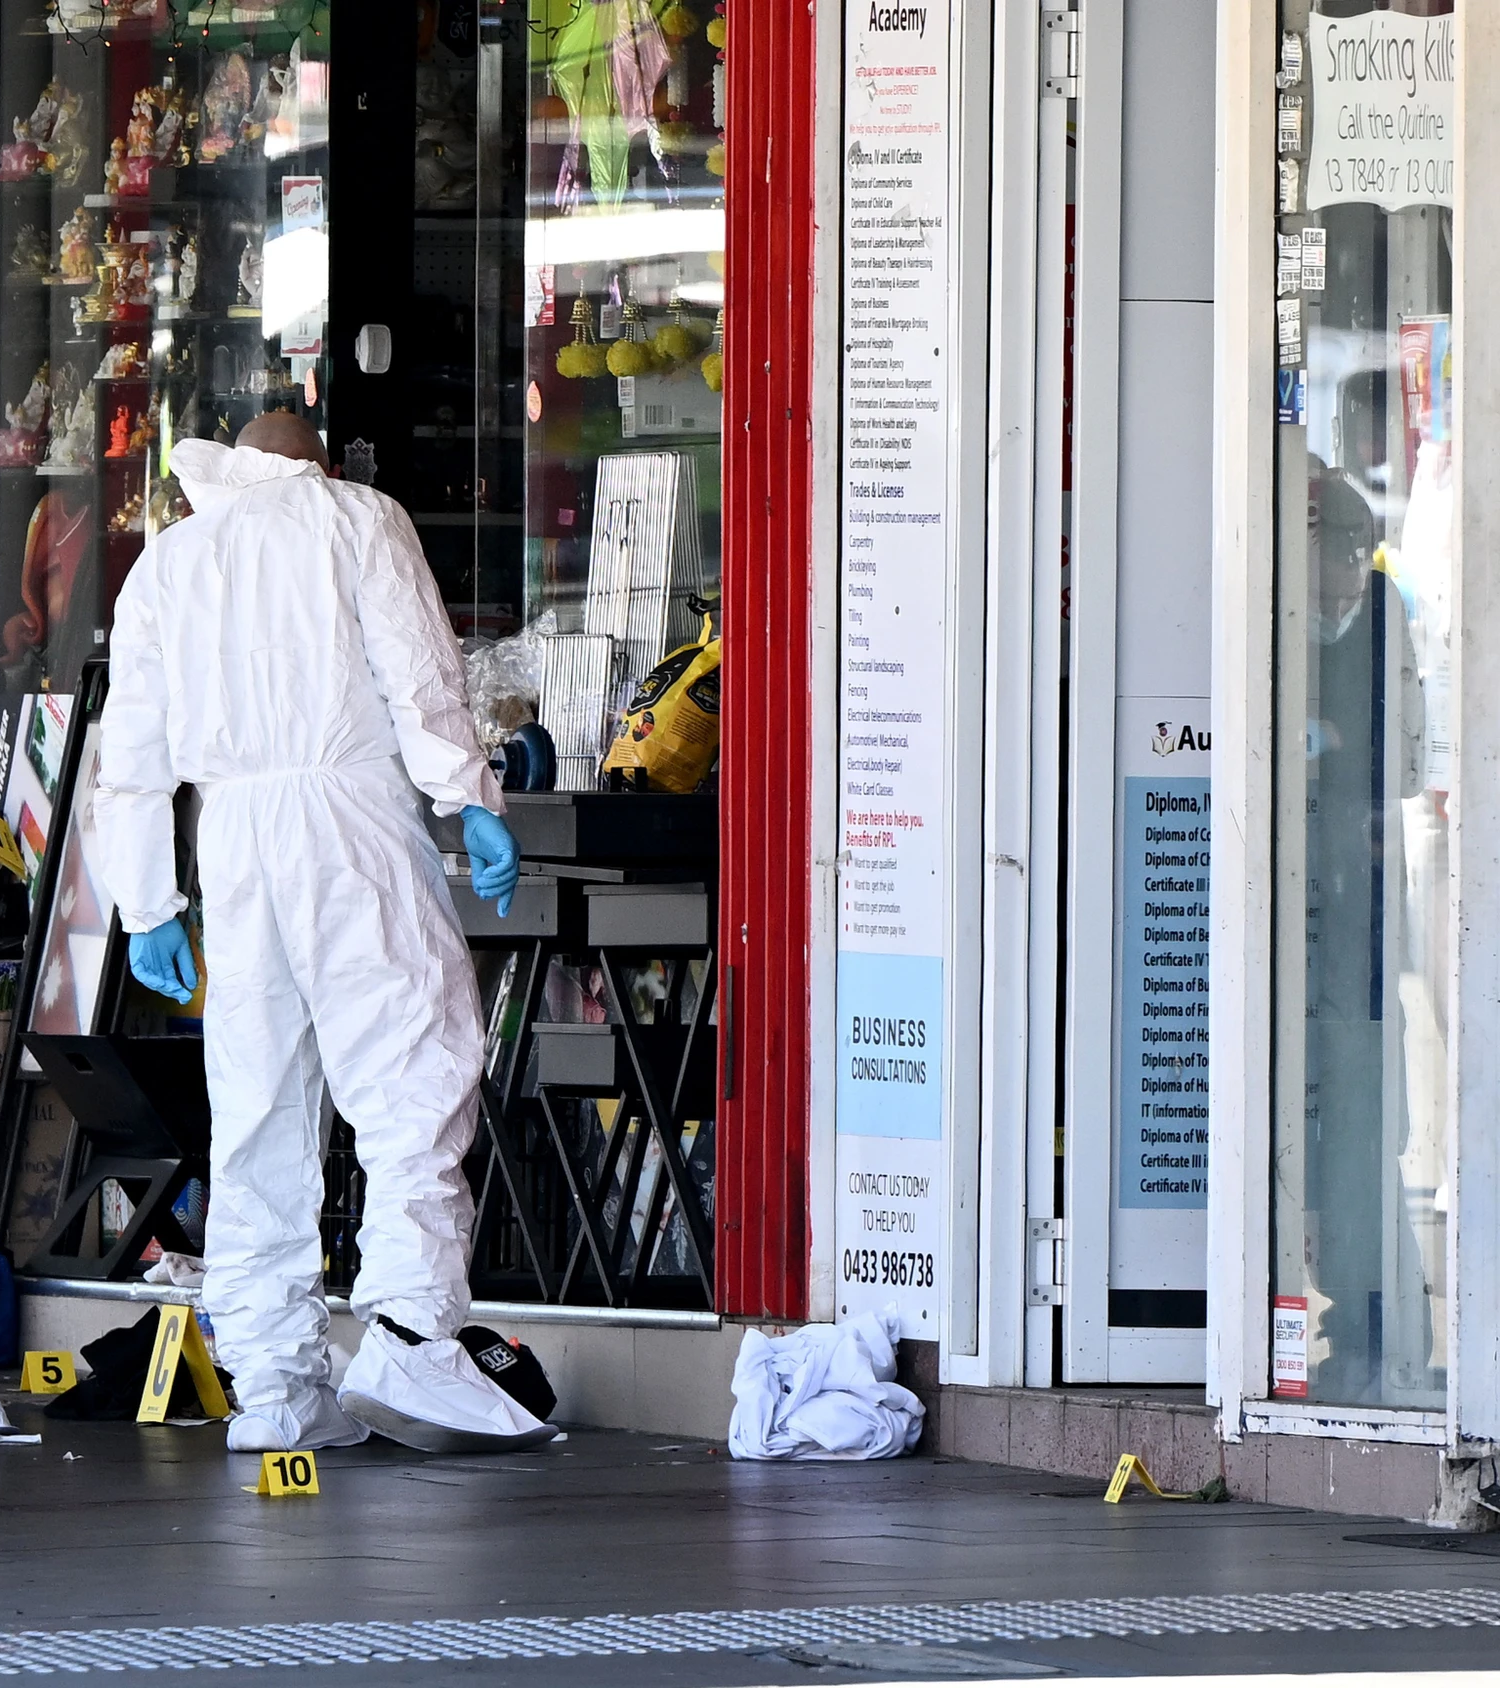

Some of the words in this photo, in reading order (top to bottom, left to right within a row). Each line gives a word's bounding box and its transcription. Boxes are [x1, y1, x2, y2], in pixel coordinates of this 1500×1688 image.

[868, 0, 927, 39] Academy
[1326, 20, 1417, 98] Smoking
[1338, 103, 1364, 140] Call
[1368, 103, 1393, 140] the
[1399, 104, 1444, 145] Quitline
[1325, 158, 1343, 192] 13
[1347, 158, 1385, 193] 7848
[1389, 166, 1400, 193] or
[1406, 159, 1420, 193] 13
[849, 481, 870, 498] Trades
[871, 481, 876, 498] &
[877, 481, 904, 498] Licenses
[849, 509, 870, 527] Building
[870, 509, 874, 523] &
[875, 510, 906, 523] construction
[907, 511, 941, 527] management
[849, 534, 874, 551] Carpentry
[848, 559, 876, 576] Bricklaying
[848, 583, 873, 601] Plumbing
[848, 633, 869, 651] Painting
[848, 658, 873, 672] Structural
[873, 659, 904, 677] landscaping
[848, 683, 868, 700] Fencing
[847, 708, 870, 721] Electrical
[871, 708, 922, 723] telecommunications
[1145, 791, 1201, 817] Diploma,
[846, 809, 857, 826] We
[858, 812, 868, 826] are
[869, 808, 884, 826] here
[885, 812, 893, 826] to
[893, 810, 909, 831] help
[909, 815, 924, 831] you.
[846, 830, 873, 847] Benefits
[873, 831, 882, 847] of
[882, 831, 897, 848] RPL.
[1144, 877, 1194, 892] Certificate
[1196, 878, 1206, 892] III
[1144, 902, 1185, 920] Diploma
[1187, 902, 1198, 917] of
[1144, 927, 1185, 945] Diploma
[1186, 927, 1198, 942] of
[1143, 952, 1193, 967] Certificate
[1194, 953, 1205, 967] IV
[1143, 977, 1184, 995] Diploma
[1185, 977, 1197, 992] of
[852, 1016, 926, 1048] BUSINESS
[851, 1057, 927, 1084] CONSULTATIONS
[1142, 1052, 1183, 1071] Diploma
[1184, 1053, 1195, 1068] of
[1141, 1077, 1182, 1095] Diploma
[1184, 1077, 1195, 1092] of
[1141, 1103, 1151, 1118] IT
[1140, 1153, 1190, 1168] Certificate
[1191, 1154, 1202, 1168] III
[849, 1172, 888, 1196] CONTACT
[888, 1174, 900, 1197] US
[901, 1175, 930, 1198] TODAY
[862, 1209, 874, 1231] TO
[875, 1210, 896, 1232] HELP
[897, 1211, 916, 1233] YOU
[843, 1248, 878, 1284] 0433
[881, 1252, 934, 1288] 986738
[1276, 1319, 1303, 1330] ULTIMATE
[1276, 1330, 1300, 1340] SECURITY
[153, 1315, 179, 1397] C
[481, 1347, 512, 1369] OLICE
[41, 1356, 63, 1385] 5
[272, 1455, 312, 1487] 10
[1112, 1460, 1131, 1492] 11
